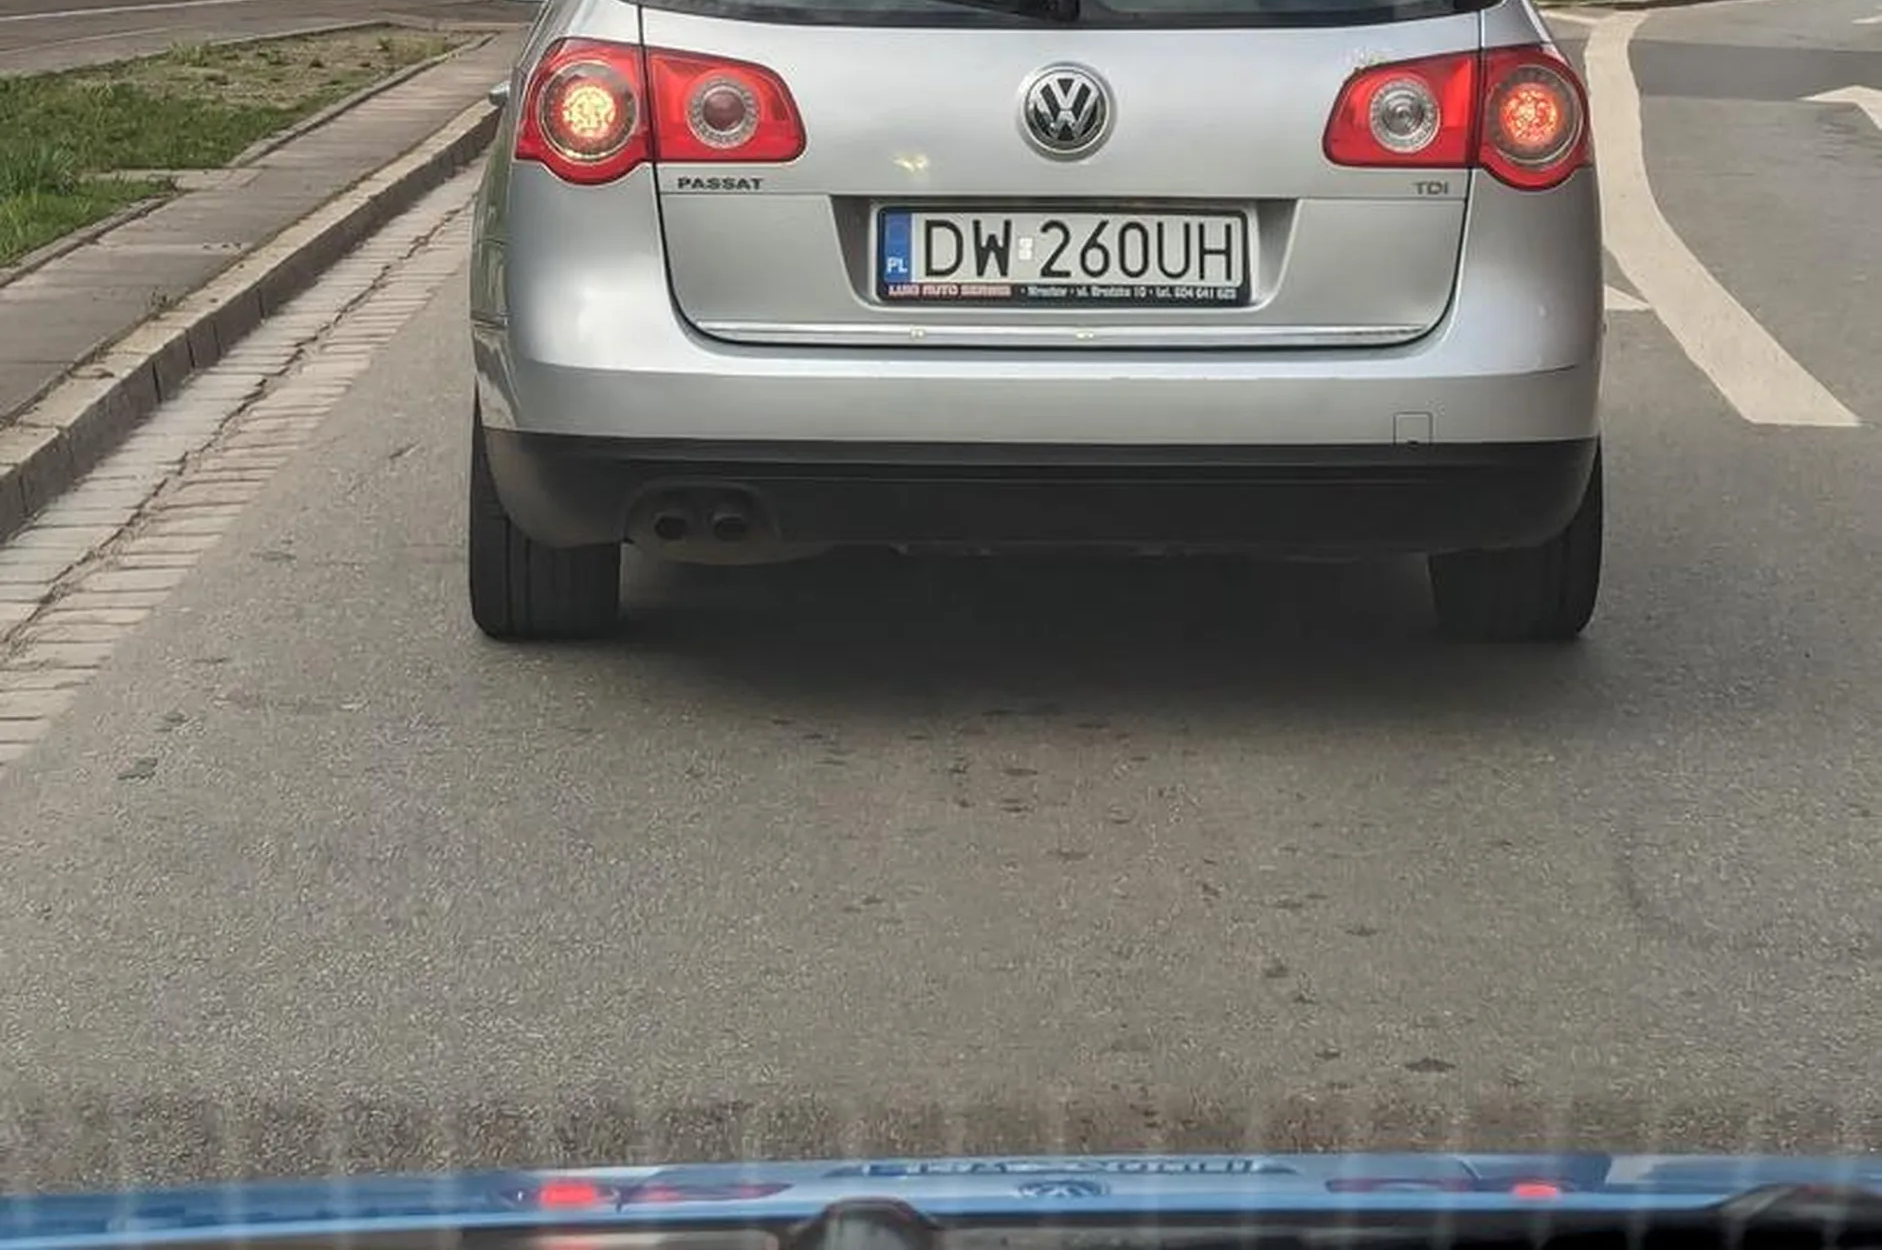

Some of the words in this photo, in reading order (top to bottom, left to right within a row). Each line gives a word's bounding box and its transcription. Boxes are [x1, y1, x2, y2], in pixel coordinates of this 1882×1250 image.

[677, 177, 764, 190] PASSAT
[1412, 181, 1449, 195] TDI
[924, 219, 1012, 278] DW
[1040, 219, 1233, 281] 260UH
[887, 257, 908, 274] PL
